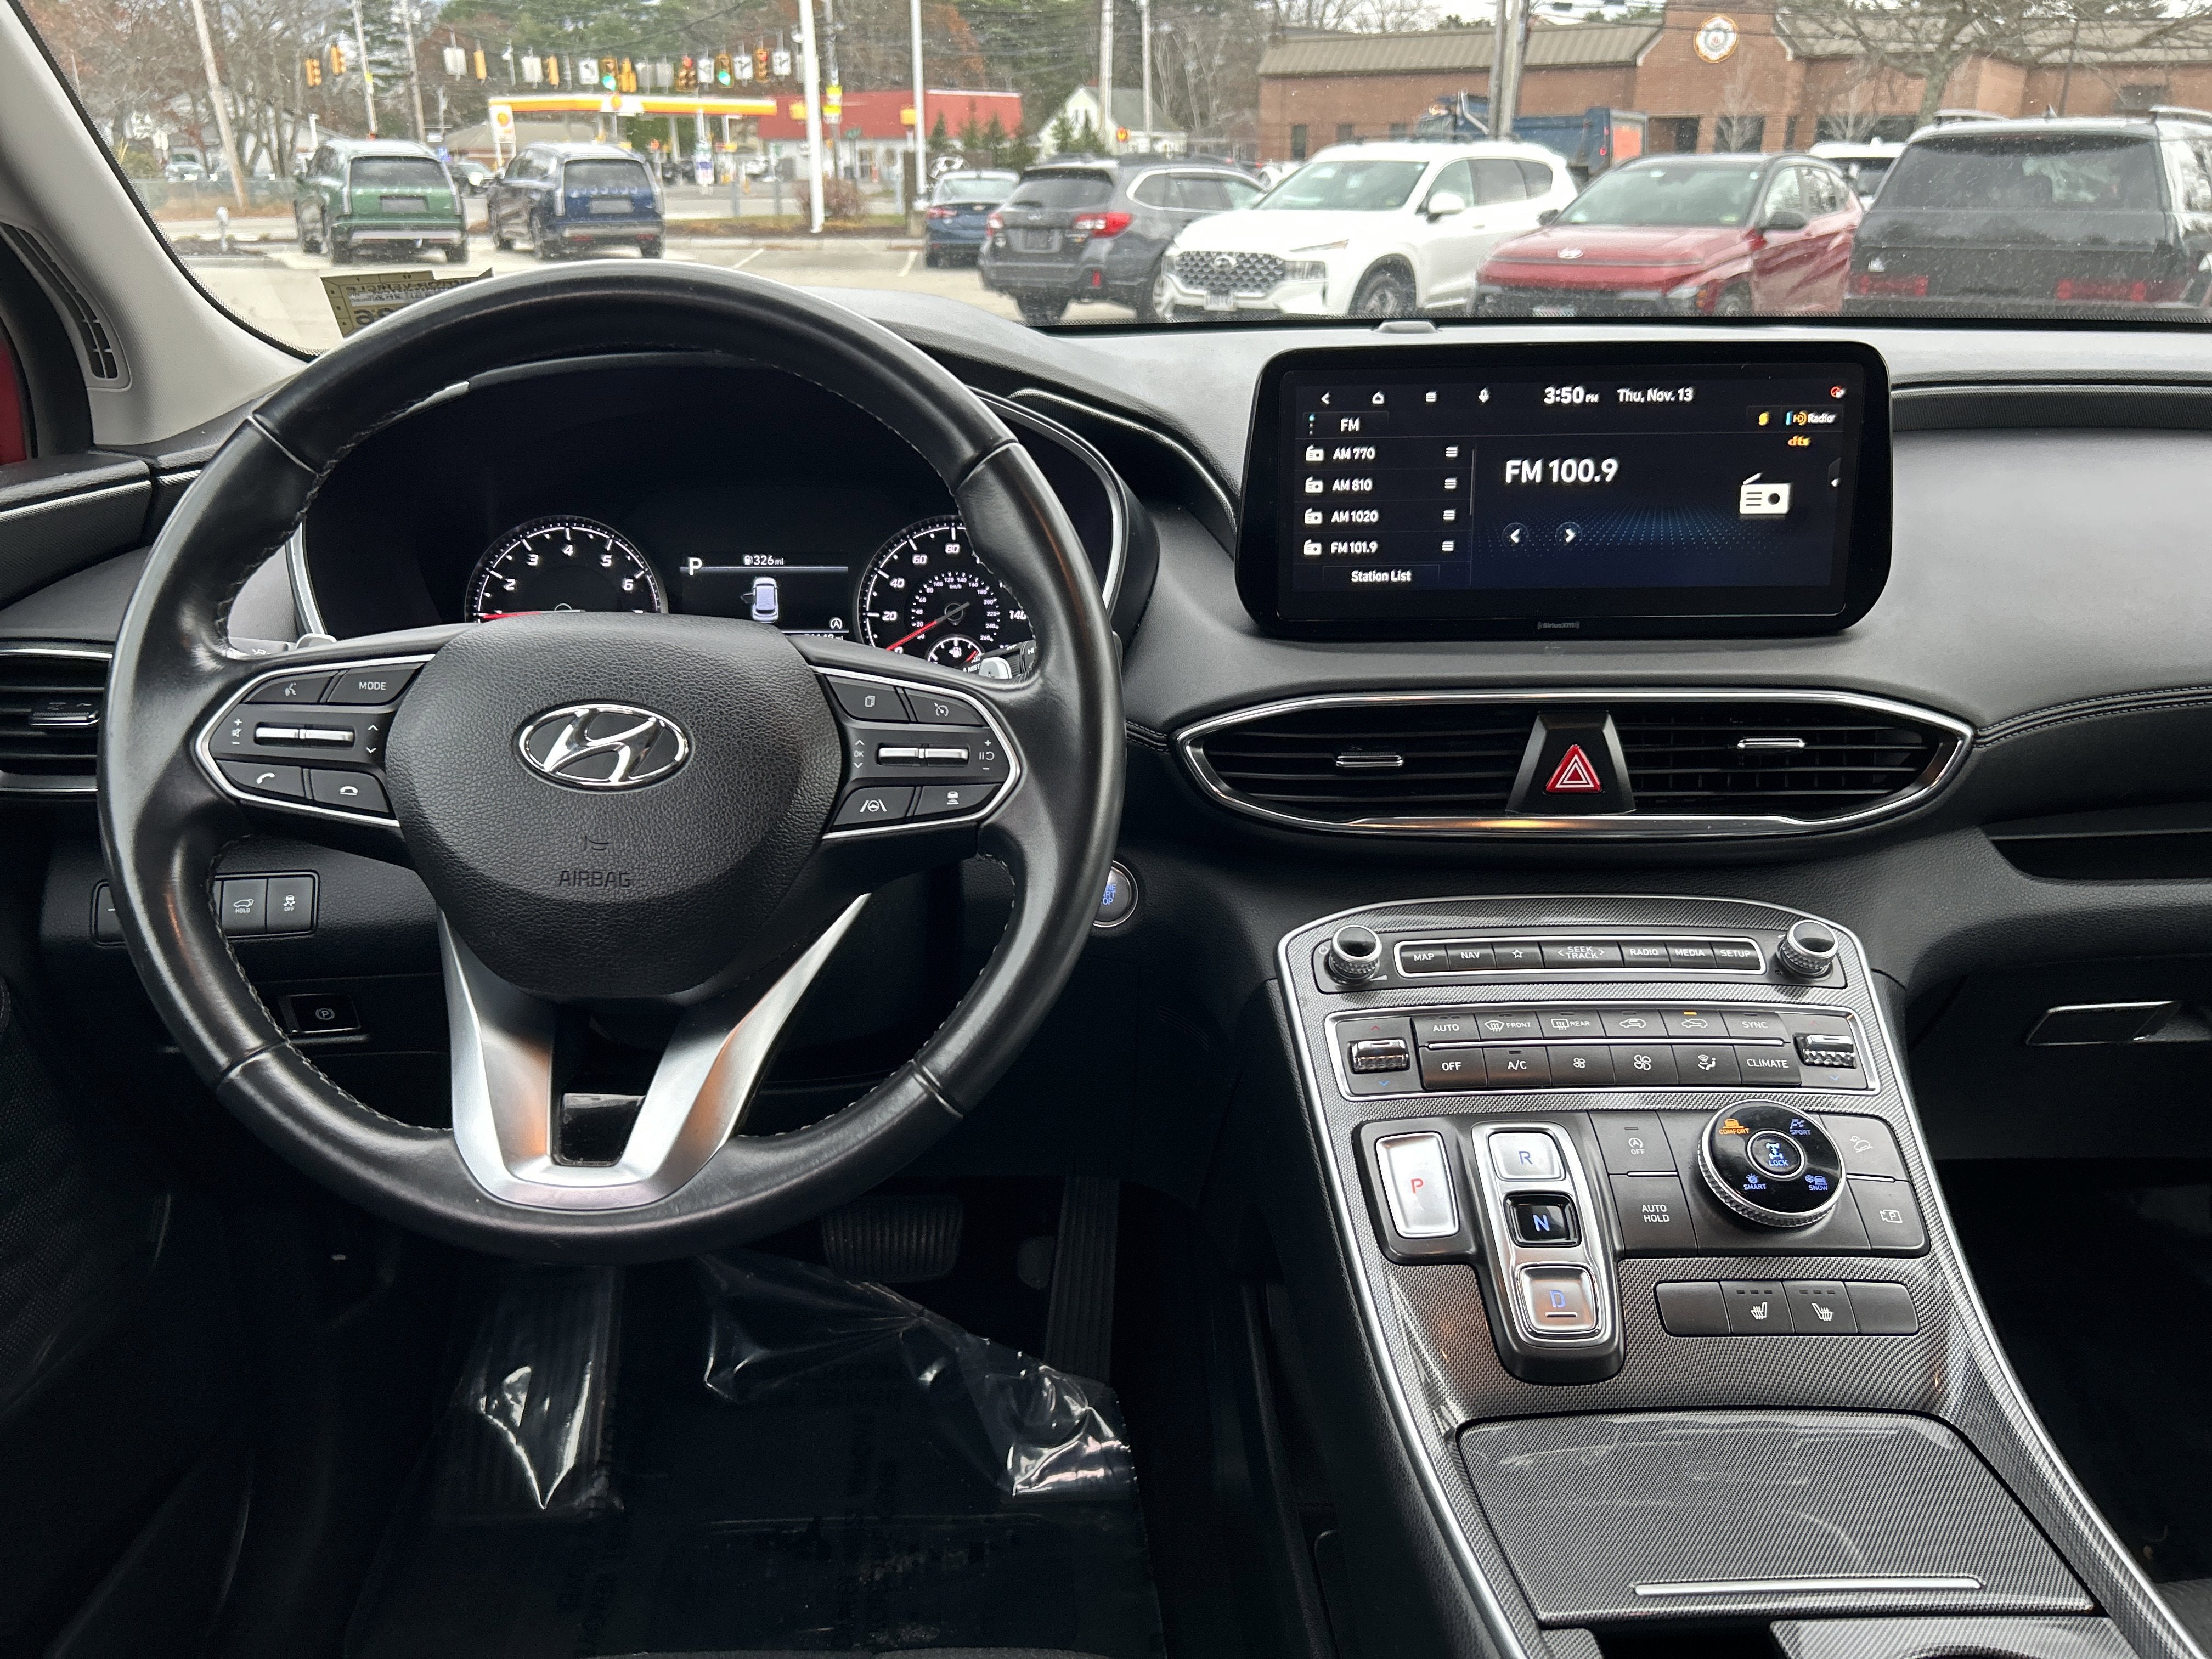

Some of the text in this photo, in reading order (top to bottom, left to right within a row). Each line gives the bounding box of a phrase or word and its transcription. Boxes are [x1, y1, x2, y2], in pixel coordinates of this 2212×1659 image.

[1543, 386, 1599, 404] 3:50 PM
[1647, 387, 1675, 402] Nov.
[1677, 387, 1694, 402] 13
[1340, 417, 1360, 432] FM
[1808, 413, 1836, 424] Radio
[1787, 435, 1810, 447] dts
[1333, 447, 1376, 460] AM 770
[1506, 458, 1618, 483] FM 100.9
[1332, 478, 1373, 492] AM 810
[1331, 509, 1379, 523] AM 1020
[561, 545, 574, 556] 4
[945, 544, 960, 554] 80
[1331, 541, 1378, 554] FM 101.9
[526, 554, 539, 566] 3
[600, 554, 612, 567] 5
[912, 553, 927, 564] 60
[688, 557, 702, 575] P
[1351, 569, 1412, 583] Station List
[504, 578, 516, 590] 2
[623, 578, 634, 591] 6
[889, 578, 905, 588] 40
[882, 611, 898, 620] 20
[359, 681, 387, 691] MODE
[559, 870, 631, 888] AIRBAG
[1413, 952, 1435, 961] MAP
[1460, 951, 1480, 959] NAV
[1675, 949, 1705, 957] MEDIA
[1720, 949, 1751, 957] SETUP
[1432, 1024, 1459, 1032] AUTO
[1741, 1020, 1769, 1029] SYNC
[1441, 1062, 1462, 1071] OFF
[1508, 1060, 1527, 1070] A/C
[1746, 1058, 1789, 1069] CLIMATE
[1518, 1150, 1533, 1165] R
[1410, 1178, 1425, 1194] P
[1642, 1204, 1667, 1212] AUTO
[1533, 1214, 1551, 1231] N
[1643, 1214, 1670, 1222] HOLD
[1550, 1290, 1566, 1308] D
